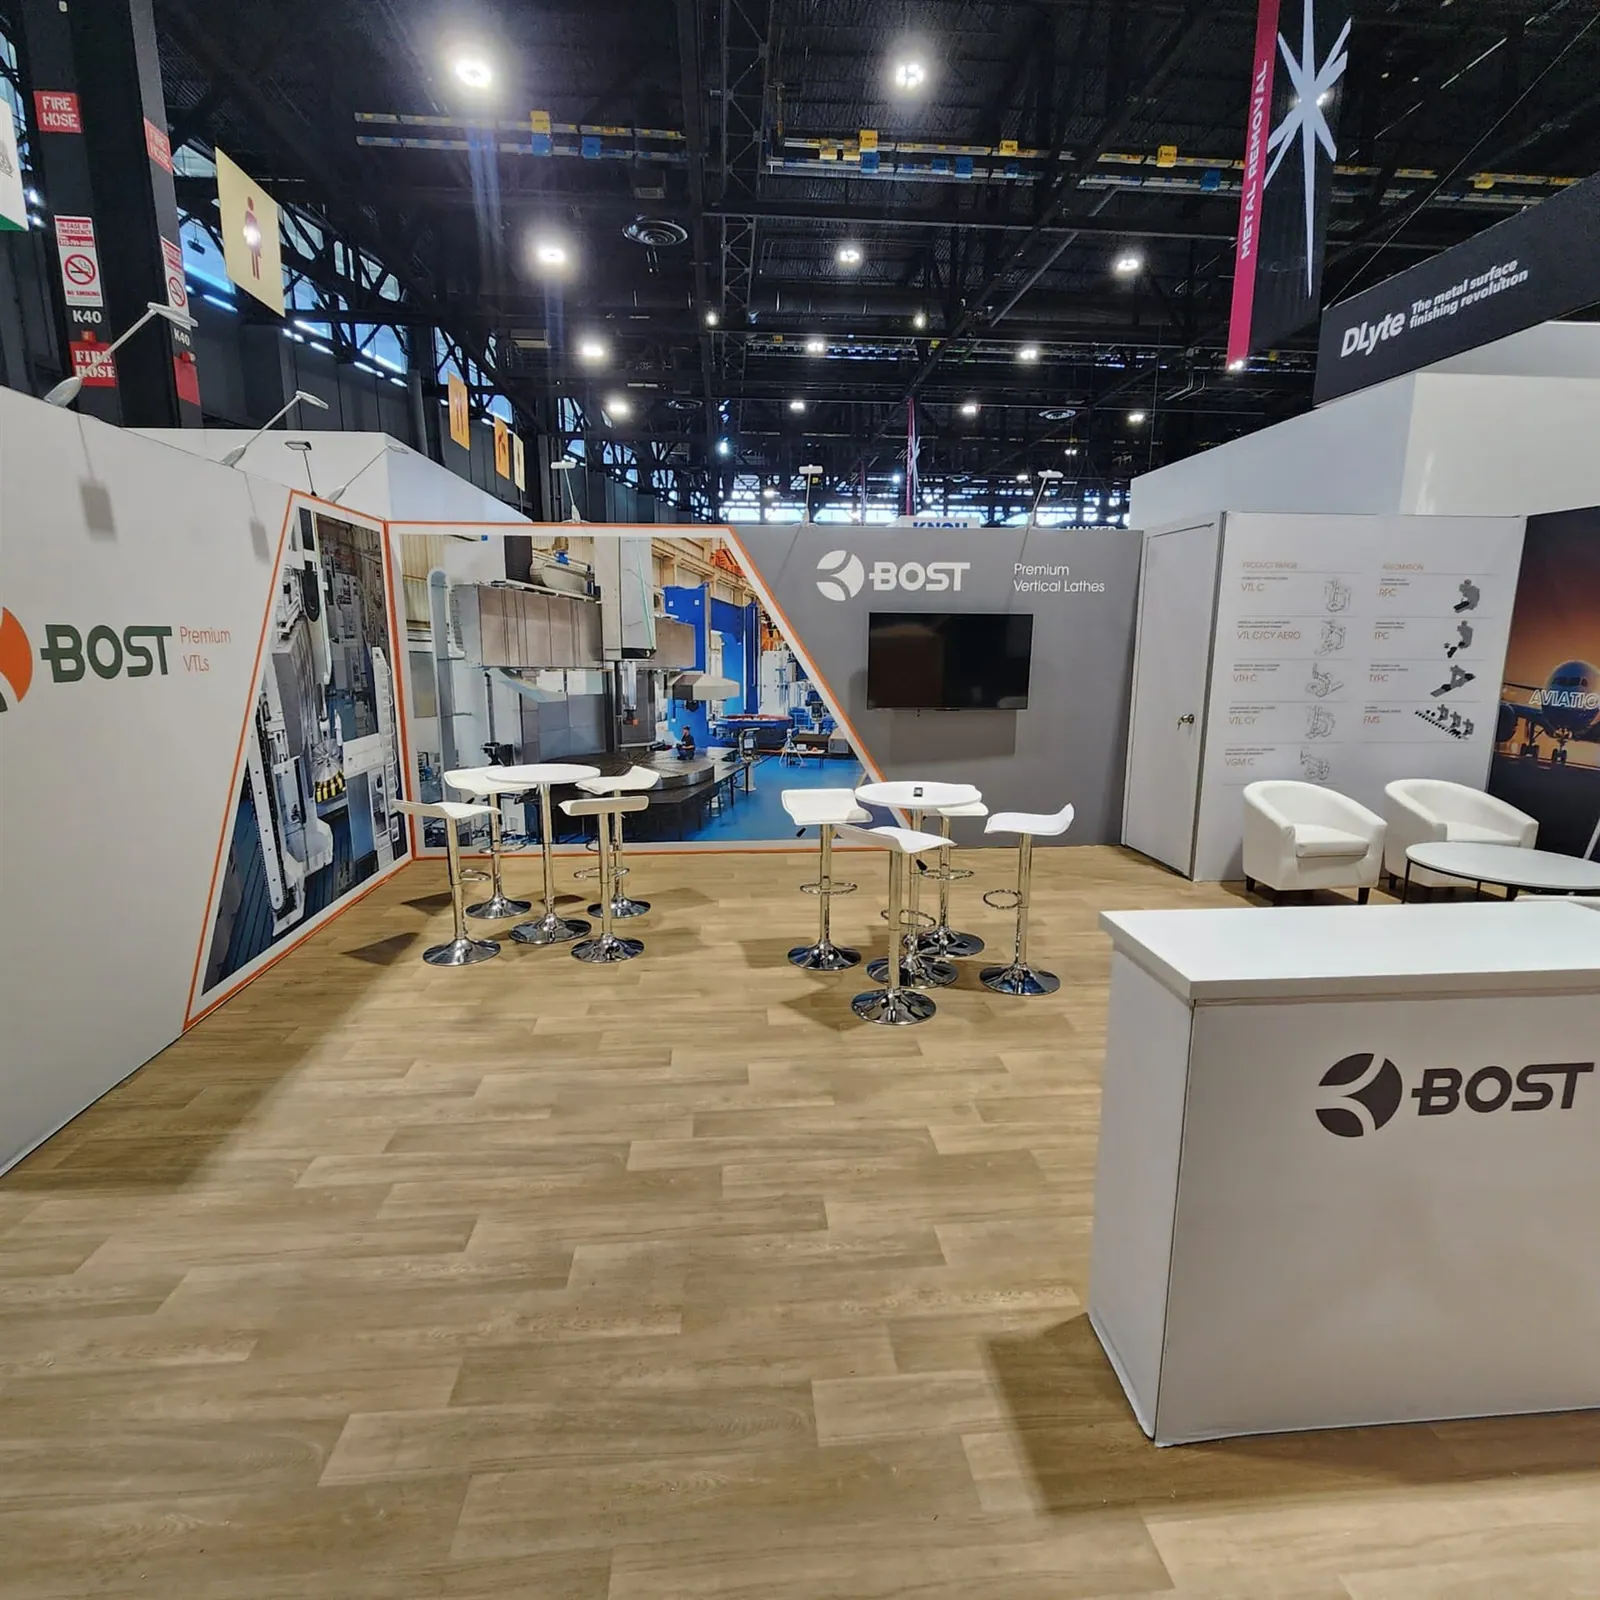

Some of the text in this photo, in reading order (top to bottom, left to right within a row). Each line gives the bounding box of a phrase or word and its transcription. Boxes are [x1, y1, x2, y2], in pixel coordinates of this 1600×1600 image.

[42, 96, 72, 111] FIRE
[42, 112, 78, 128] HOSE
[1240, 60, 1268, 260] METAL REMOVAL
[66, 222, 81, 230] CASE
[1411, 259, 1519, 315] The metal surface
[1409, 269, 1529, 330] finishing revolution
[72, 310, 102, 324] K40
[173, 327, 191, 347] K40
[1340, 311, 1406, 358] DLyte
[868, 561, 971, 592] BOST
[1013, 562, 1070, 576] Premium
[1013, 579, 1105, 593] Vertical Lathes
[1256, 582, 1265, 592] C
[179, 626, 232, 644] Premium
[1277, 630, 1301, 641] AERO
[40, 624, 172, 683] BOST
[183, 654, 210, 672] VTLs
[1249, 673, 1258, 682] C
[1528, 689, 1600, 710] AVIATIO
[1411, 1062, 1594, 1116] BOST
